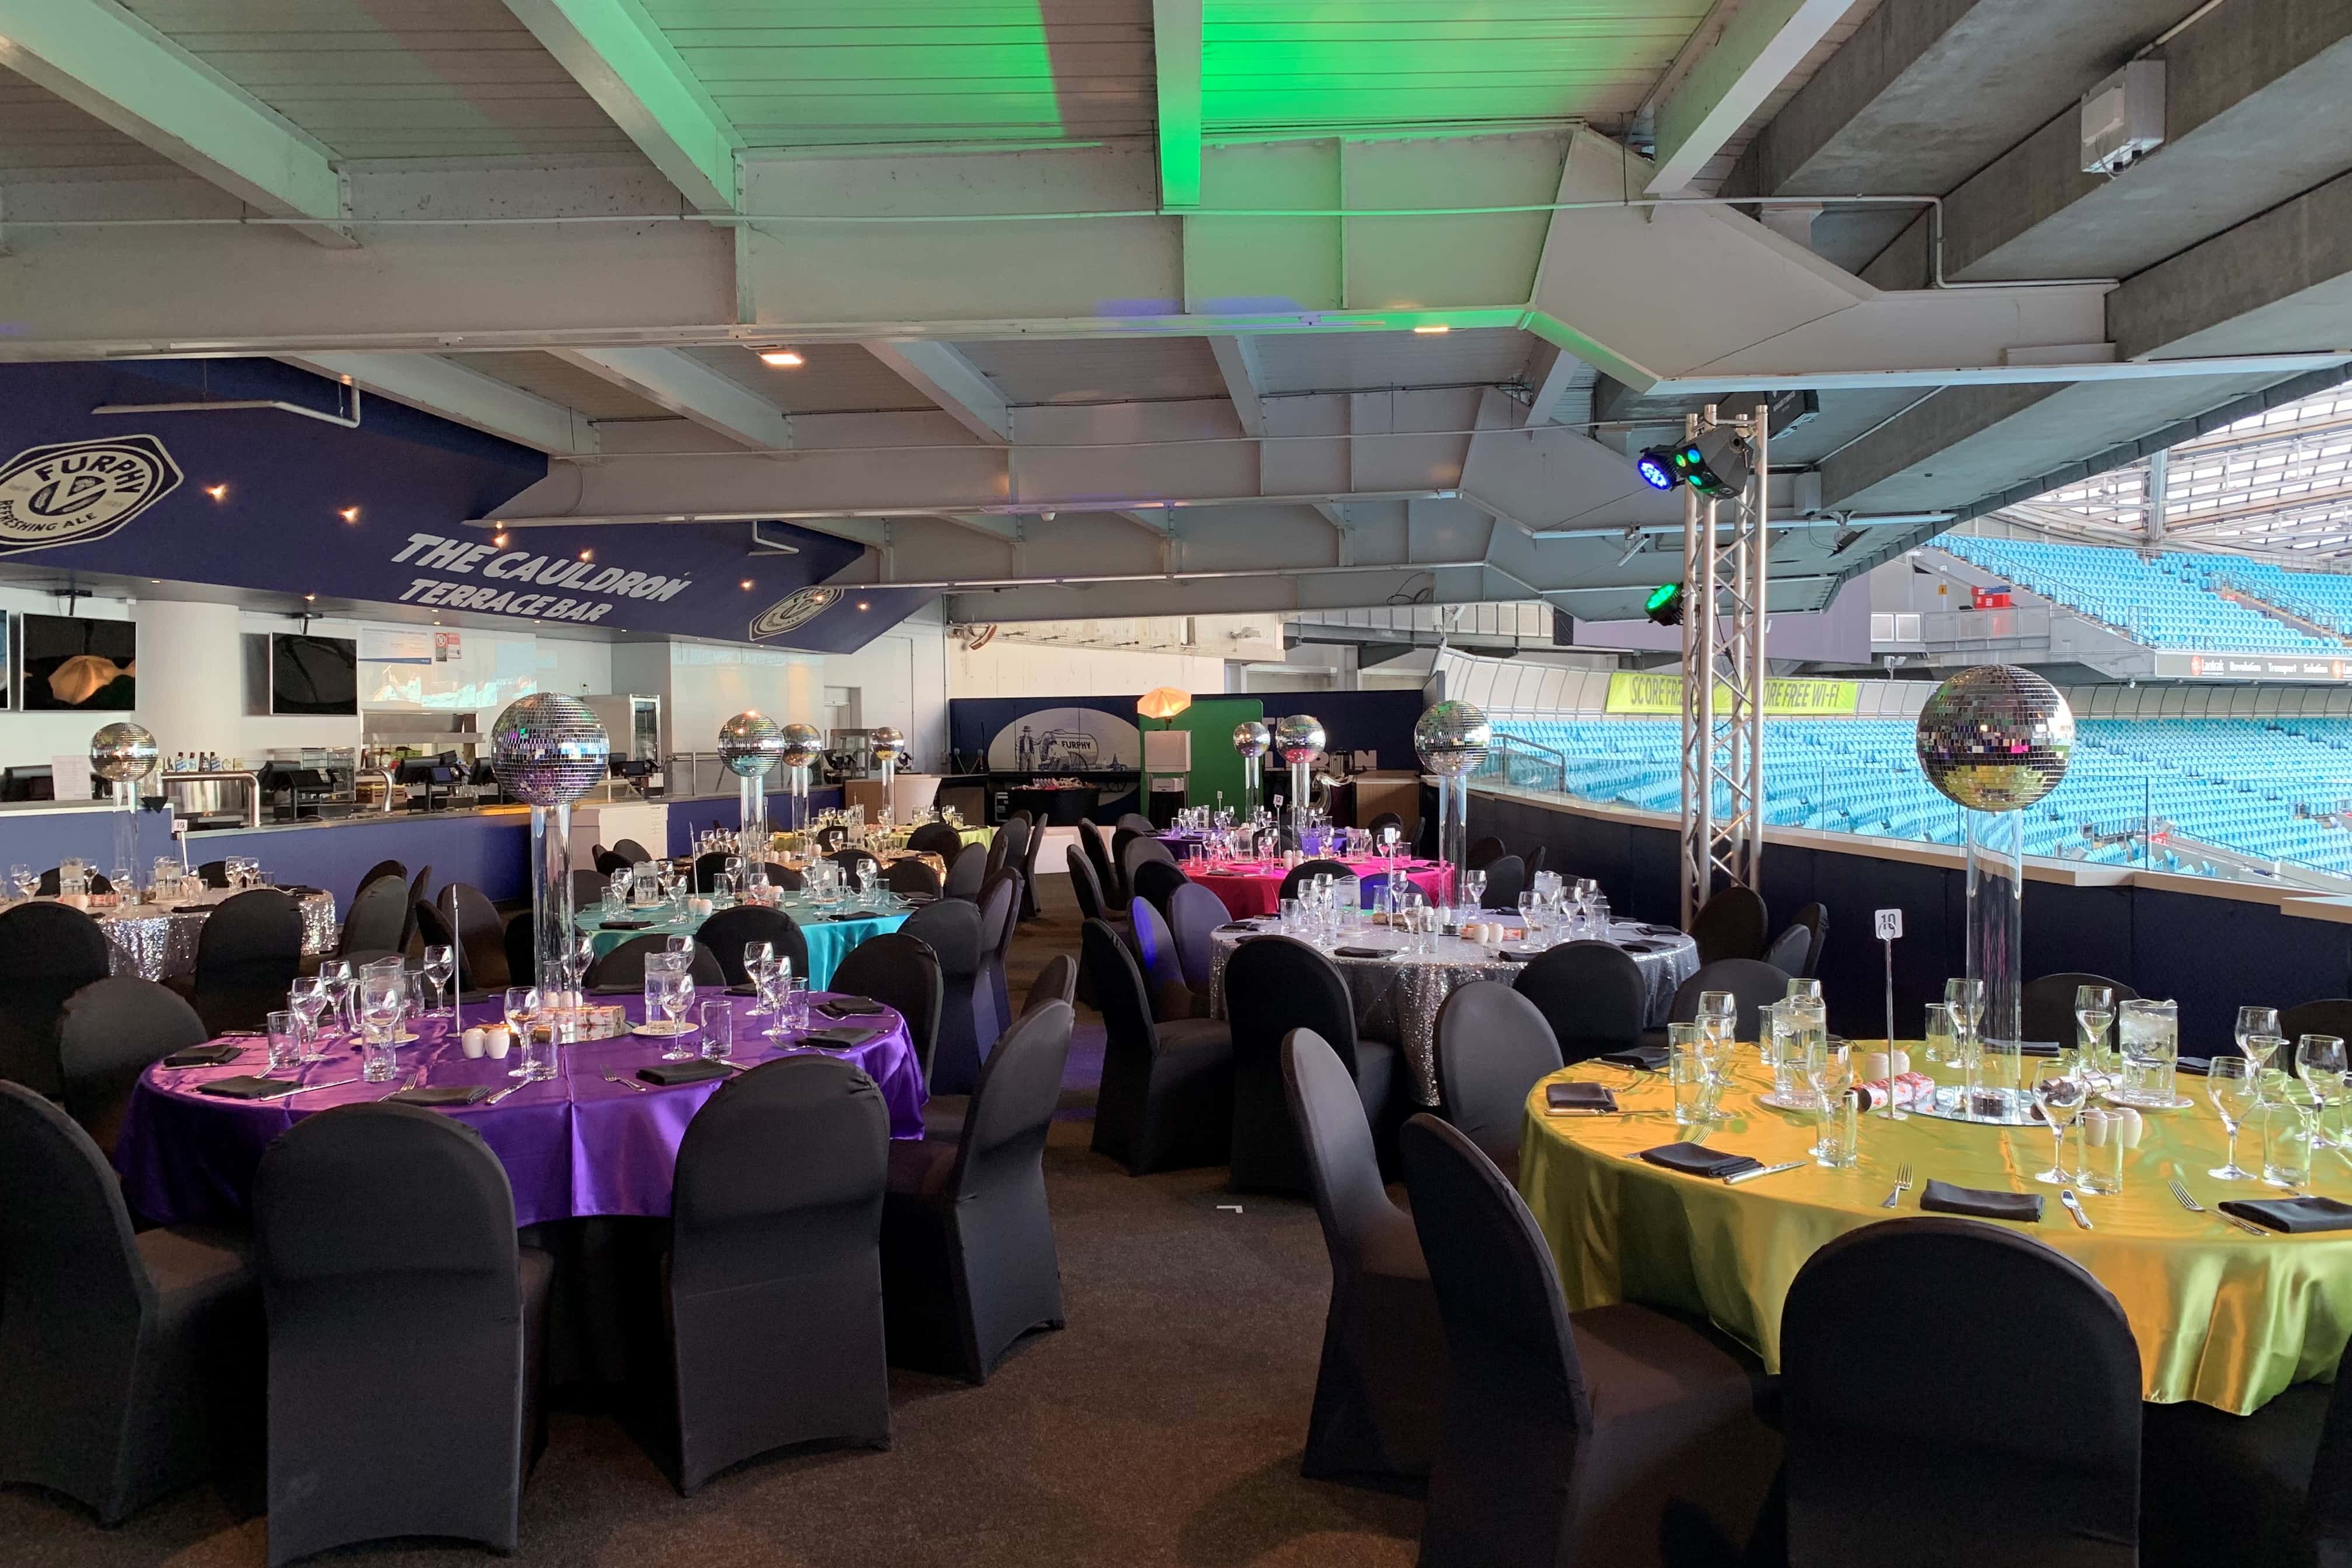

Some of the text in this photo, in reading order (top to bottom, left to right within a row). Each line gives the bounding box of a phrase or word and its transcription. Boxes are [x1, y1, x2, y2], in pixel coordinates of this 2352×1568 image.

[34, 455, 145, 494] FURPHY
[63, 513, 97, 528] ALE
[391, 533, 693, 601] THE CAULDRON
[398, 578, 613, 622] TERRACE BAR
[1631, 676, 1665, 705] SCORE
[1665, 678, 1683, 706] FRE
[1782, 683, 1811, 707] FREE
[1811, 684, 1840, 708] WI-FI
[1061, 741, 1091, 750] FURPHY
[1881, 914, 1896, 930] 10
